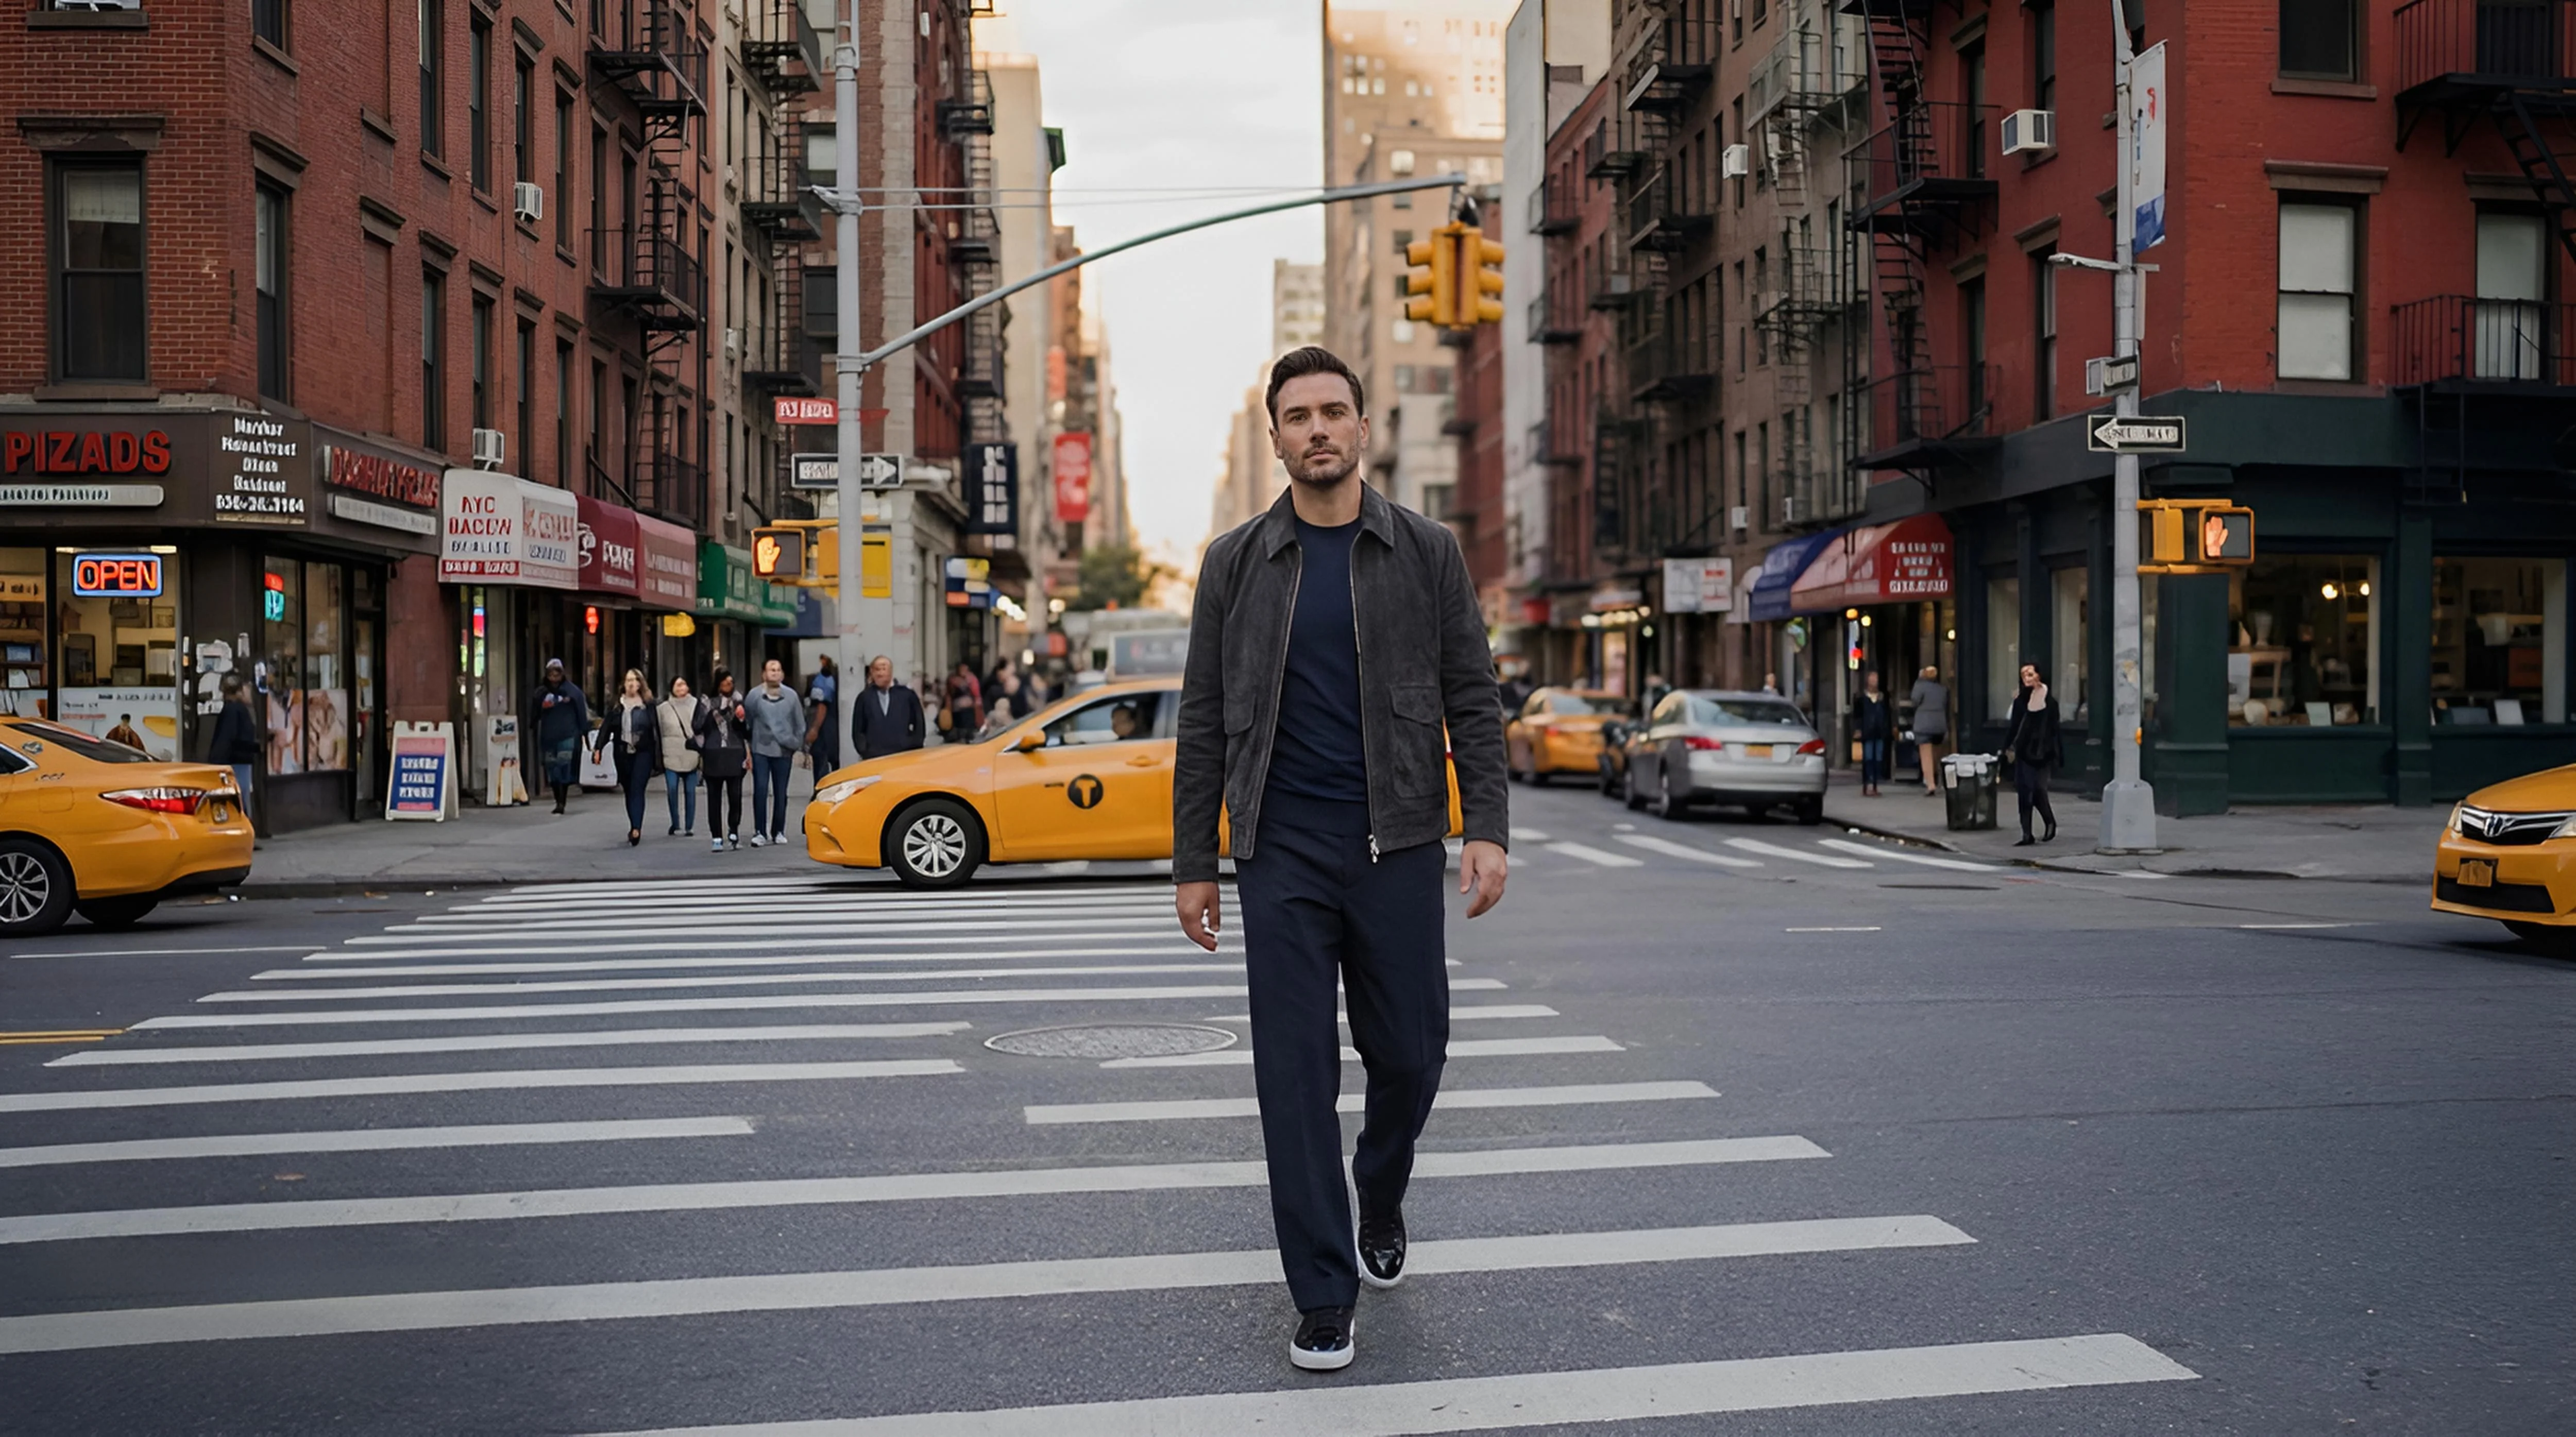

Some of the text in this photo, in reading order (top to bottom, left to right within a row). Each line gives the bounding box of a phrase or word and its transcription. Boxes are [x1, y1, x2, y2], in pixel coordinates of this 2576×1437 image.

[5, 430, 171, 472] PIZADS
[78, 560, 157, 590] OPEN
[1076, 779, 1097, 807] T
